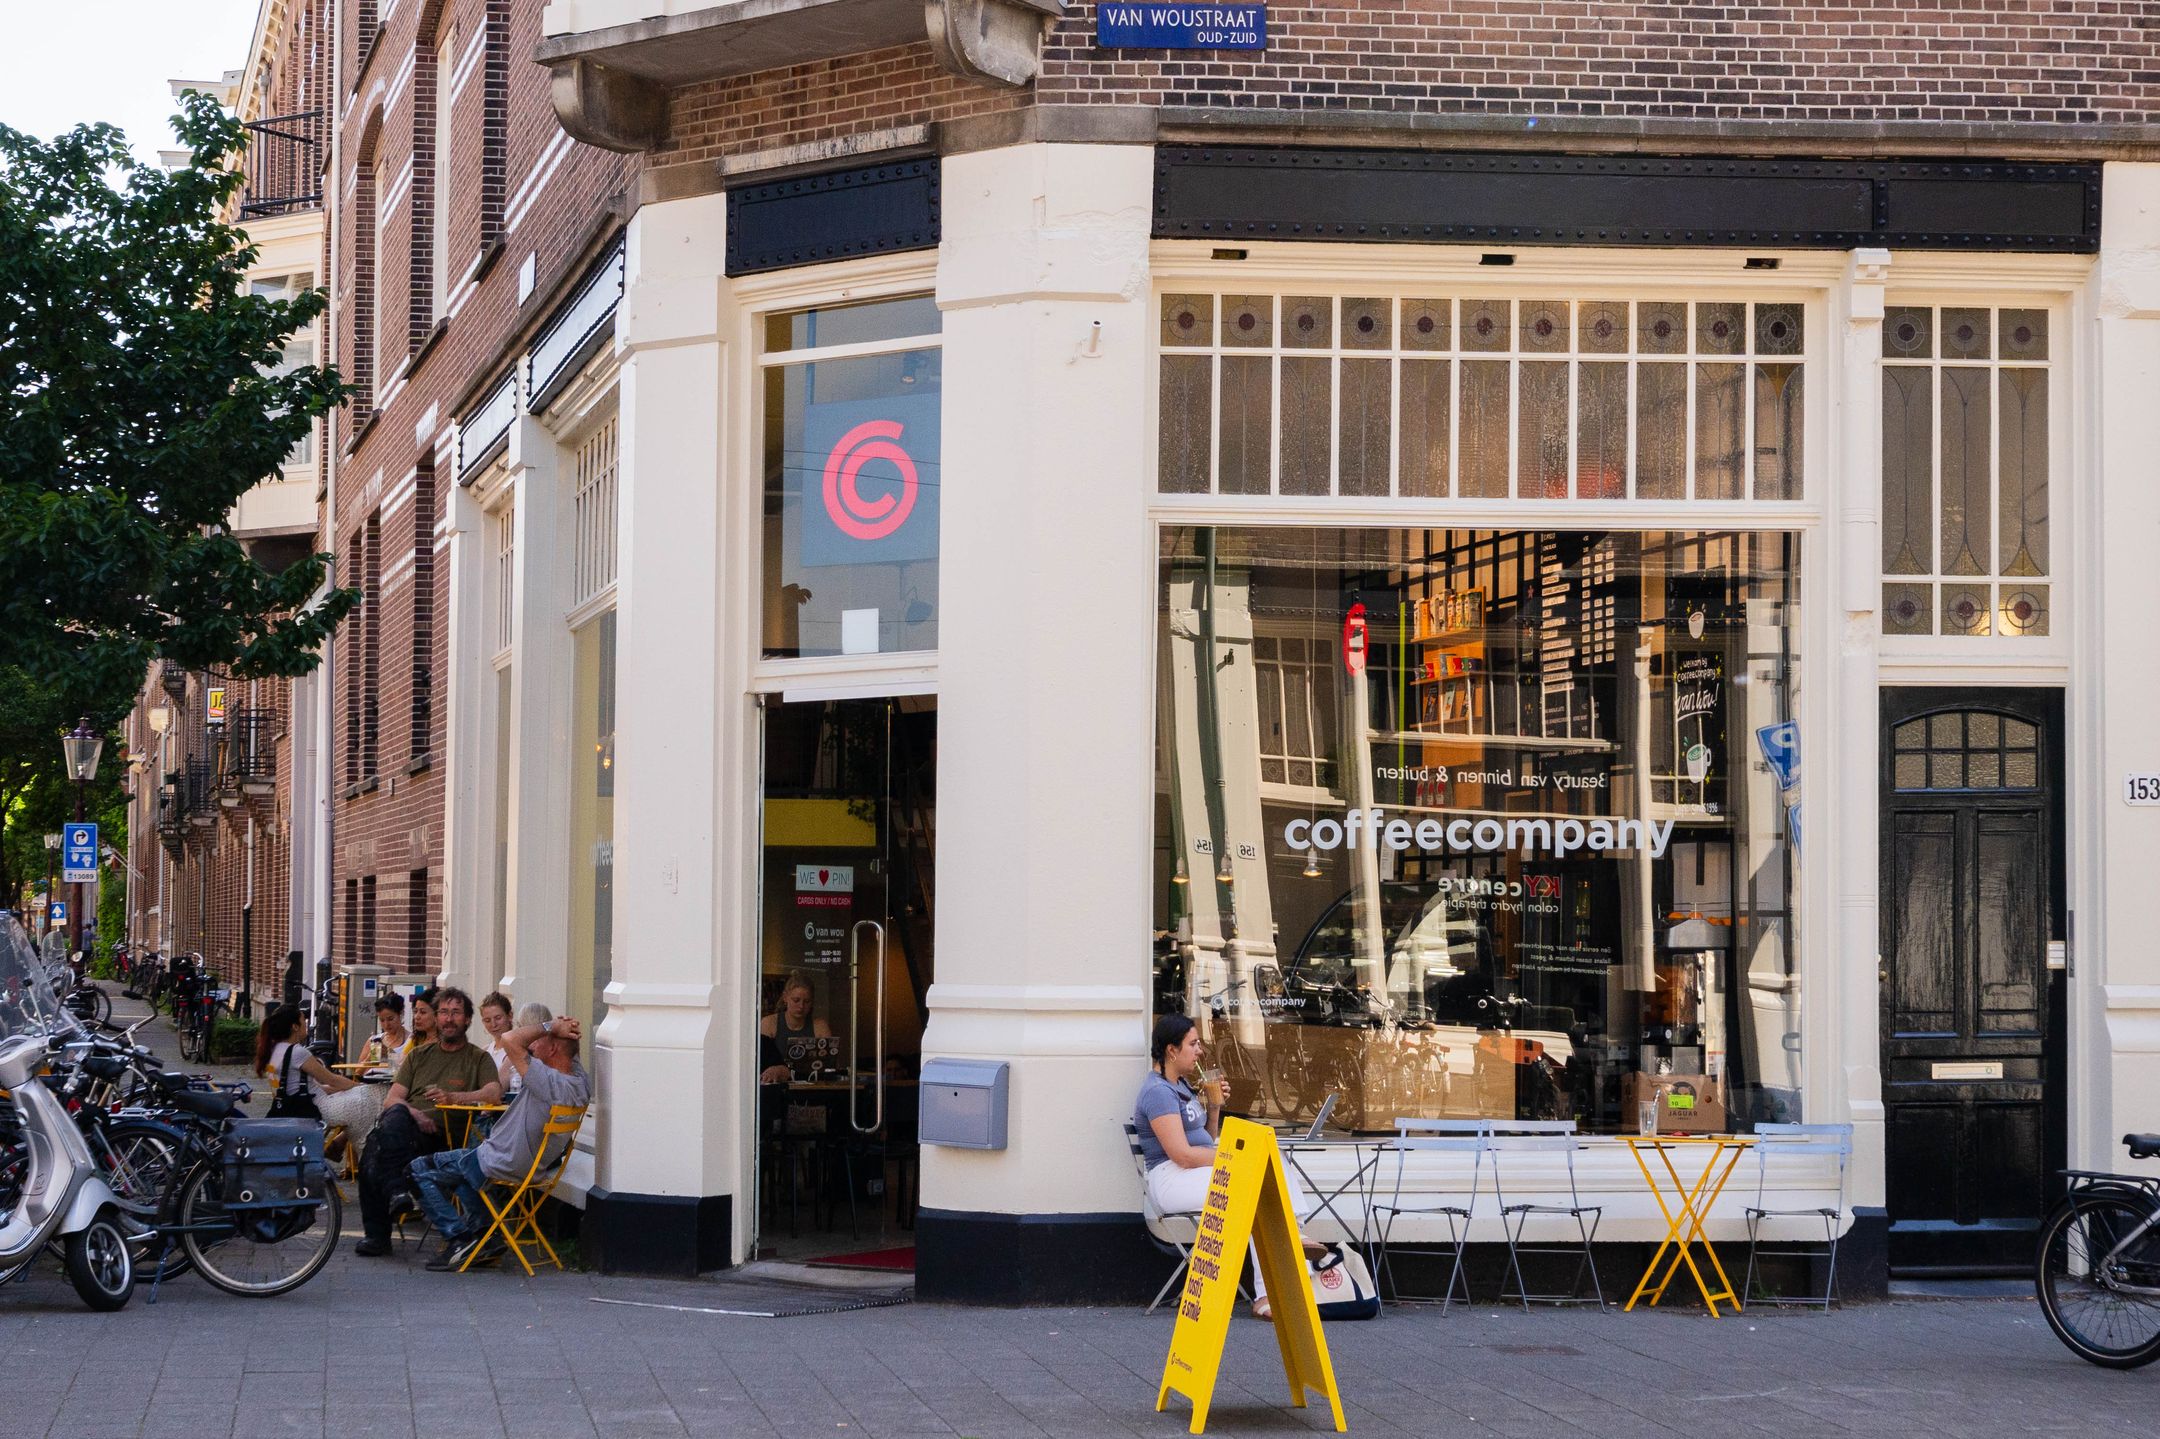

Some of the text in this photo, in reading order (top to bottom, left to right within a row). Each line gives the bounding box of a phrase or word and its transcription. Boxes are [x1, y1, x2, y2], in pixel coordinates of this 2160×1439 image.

[1107, 9, 1256, 28] VAN WOUSTRAAT
[1198, 32, 1257, 44] OUD-ZUID
[2128, 777, 2160, 800] 153
[1284, 808, 1674, 860] coffeecompany
[800, 871, 850, 885] WE PIN!
[1213, 1166, 1231, 1188] coffee
[1208, 1190, 1229, 1212] matcha
[1202, 1211, 1225, 1234] pastries
[1197, 1229, 1224, 1258] breakfast
[1192, 1255, 1220, 1281] smoothies
[1186, 1299, 1201, 1322] smile
